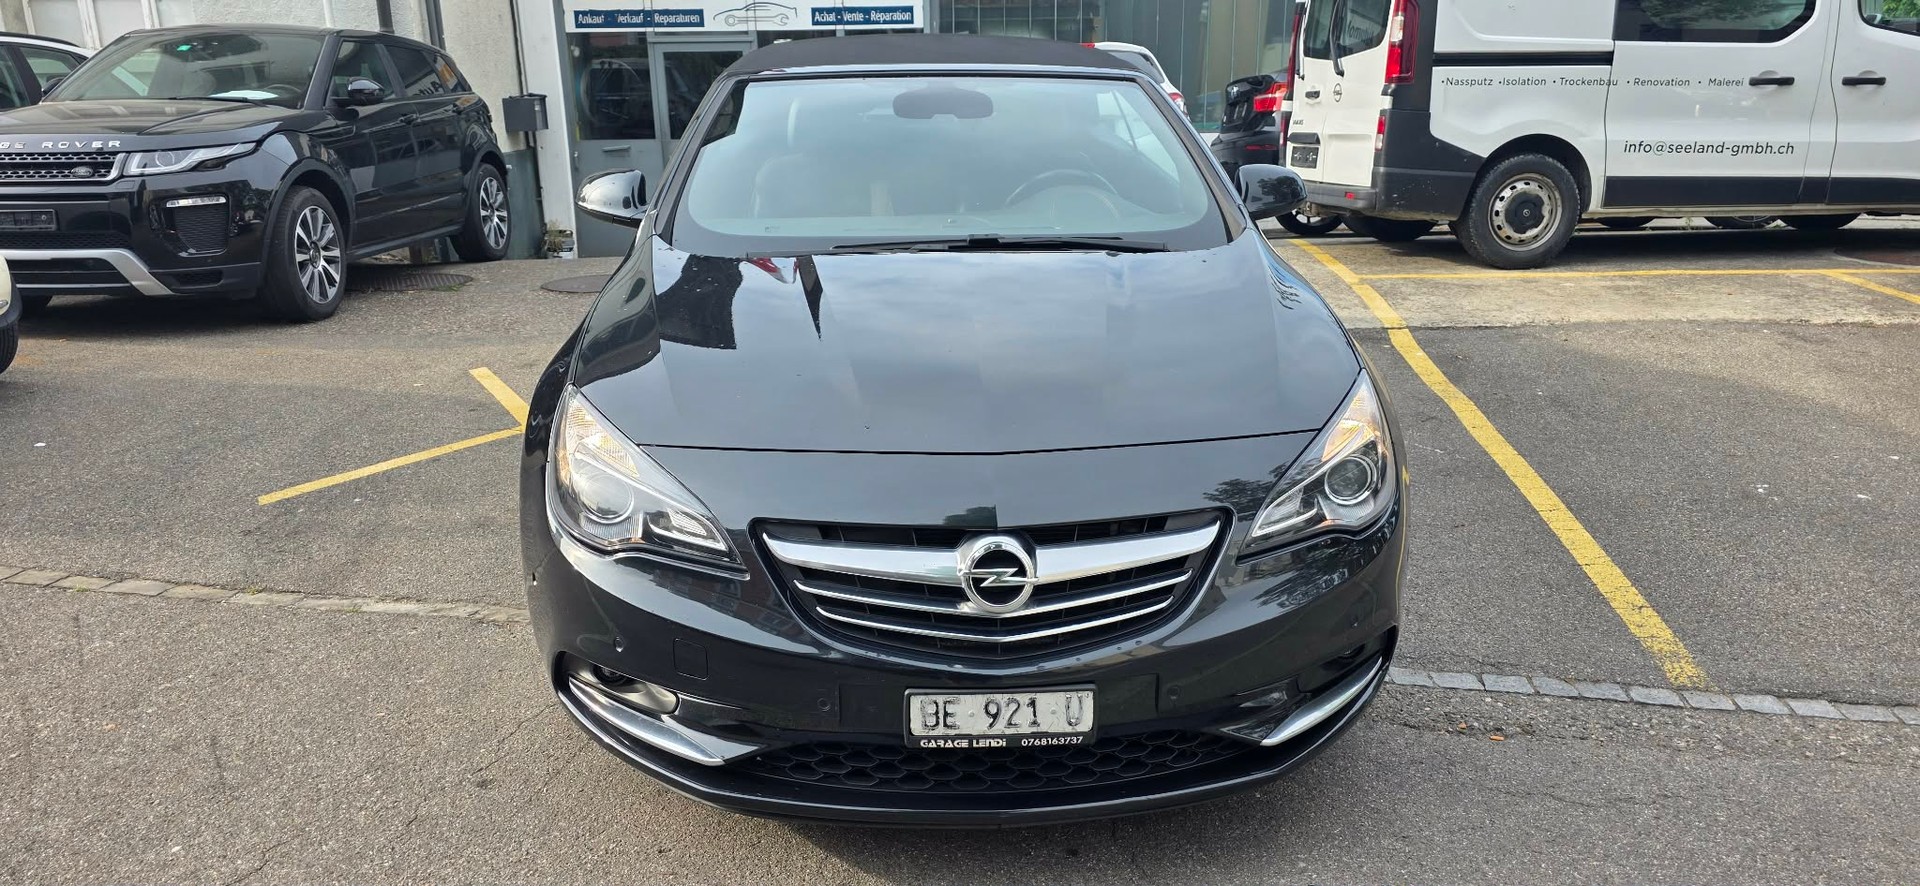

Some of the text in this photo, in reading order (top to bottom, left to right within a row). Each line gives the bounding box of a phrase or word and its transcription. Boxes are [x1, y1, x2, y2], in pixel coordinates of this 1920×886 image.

[654, 13, 700, 25] Reparaturen
[814, 9, 911, 23] Achat Vente Réparation
[1559, 77, 1618, 86] Trockenbau
[1633, 77, 1690, 86] Renovation
[1708, 78, 1744, 86] Malerei
[42, 140, 120, 149] ROVER
[1623, 140, 1795, 156] info@seeland-gmbh.ch
[920, 693, 1083, 730] BE 921 U
[920, 739, 969, 748] GARAGE
[1021, 736, 1084, 747] 0768163737
